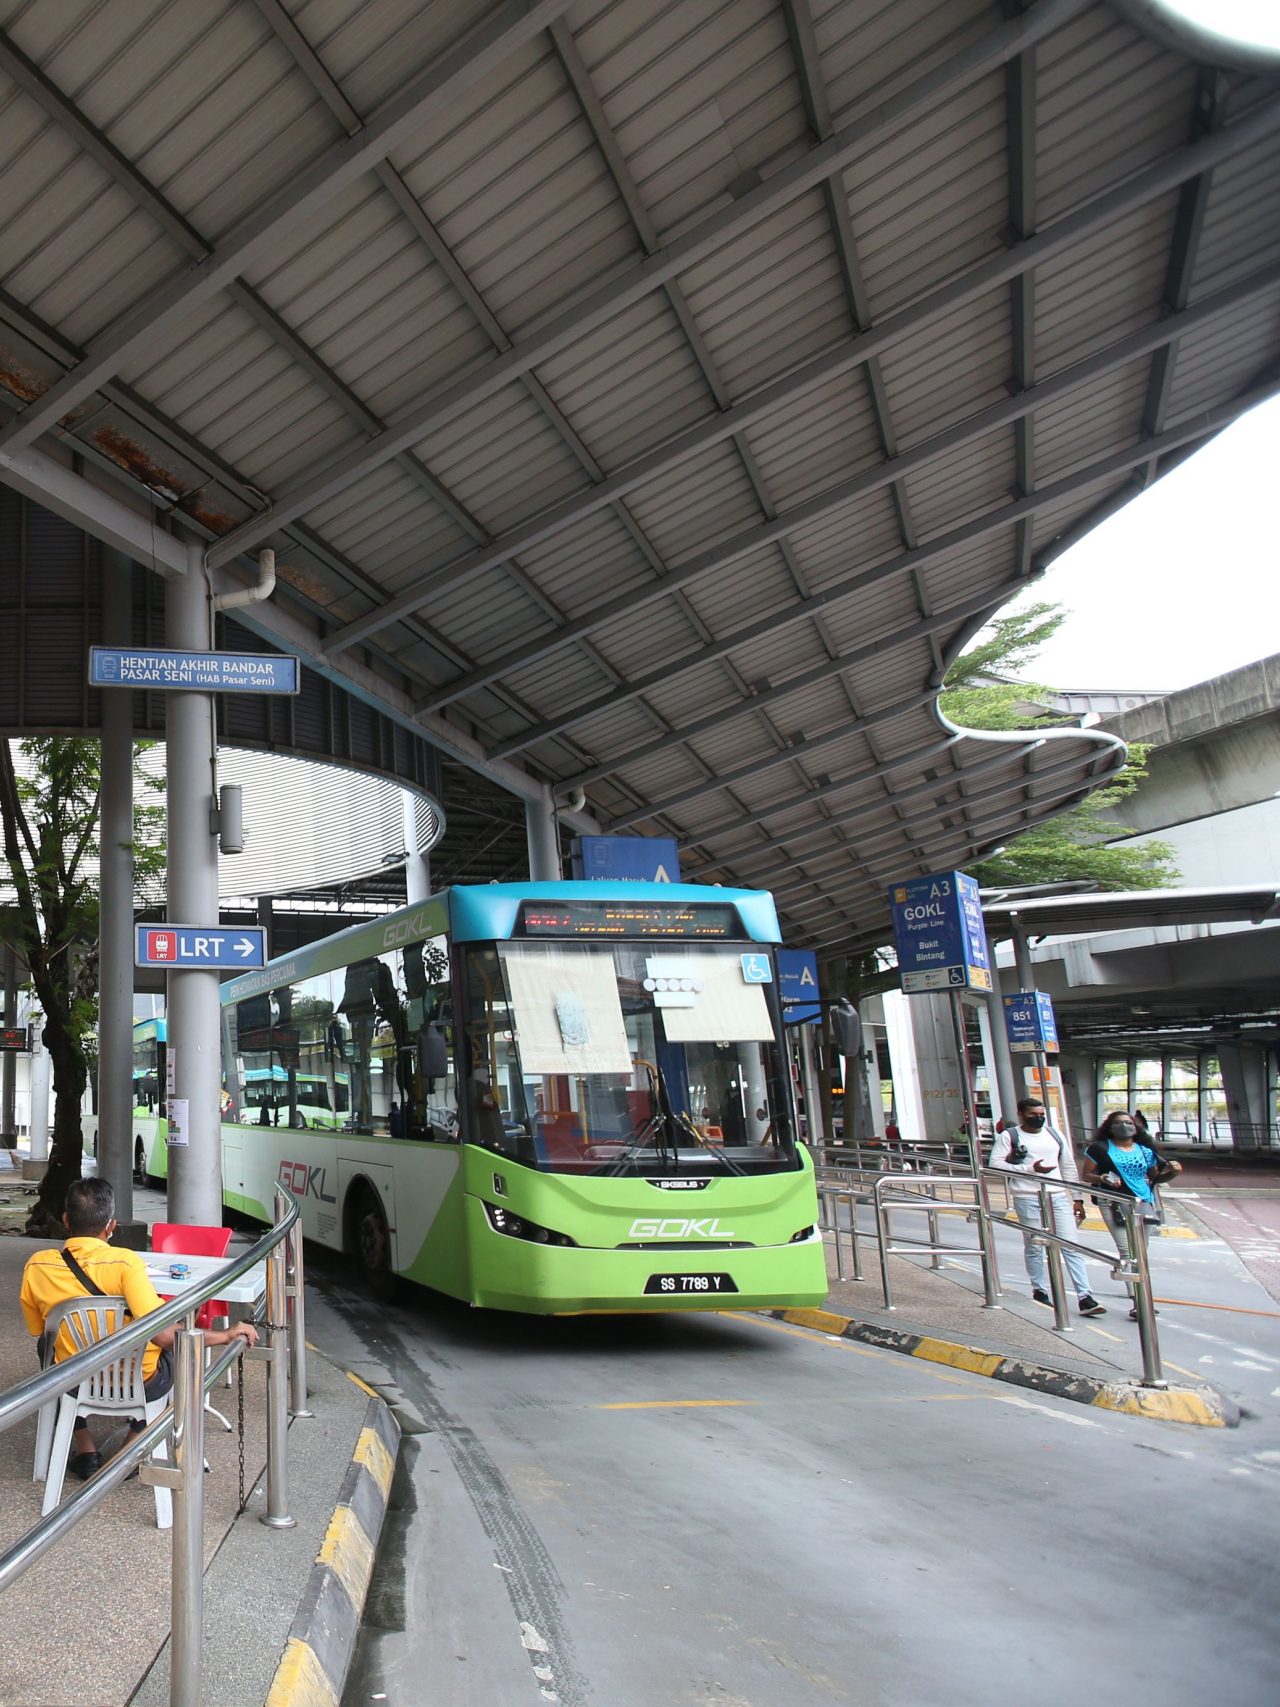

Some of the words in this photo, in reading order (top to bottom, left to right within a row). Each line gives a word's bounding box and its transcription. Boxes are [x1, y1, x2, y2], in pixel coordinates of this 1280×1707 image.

[120, 657, 176, 670] HENTIAN
[180, 659, 218, 672] AKHIR
[222, 661, 273, 675] BANDAR
[120, 669, 161, 681] PASAR
[164, 670, 192, 682] SENI
[196, 674, 220, 684] (HAB
[222, 675, 247, 685] Pasar
[250, 676, 275, 687] Seni)
[653, 864, 671, 884] A
[930, 880, 951, 899] A3
[903, 902, 946, 921] GOKL
[383, 911, 433, 948] GOKL
[907, 922, 928, 931] Purple
[180, 937, 225, 958] LRT
[918, 940, 939, 950] Bukit
[915, 951, 945, 962] Bintang
[800, 966, 815, 986] A
[1012, 1010, 1031, 1022] 851
[628, 1218, 735, 1238] GOKL
[660, 1277, 676, 1291] SS
[680, 1277, 709, 1290] 7789
[713, 1276, 721, 1290] Y
